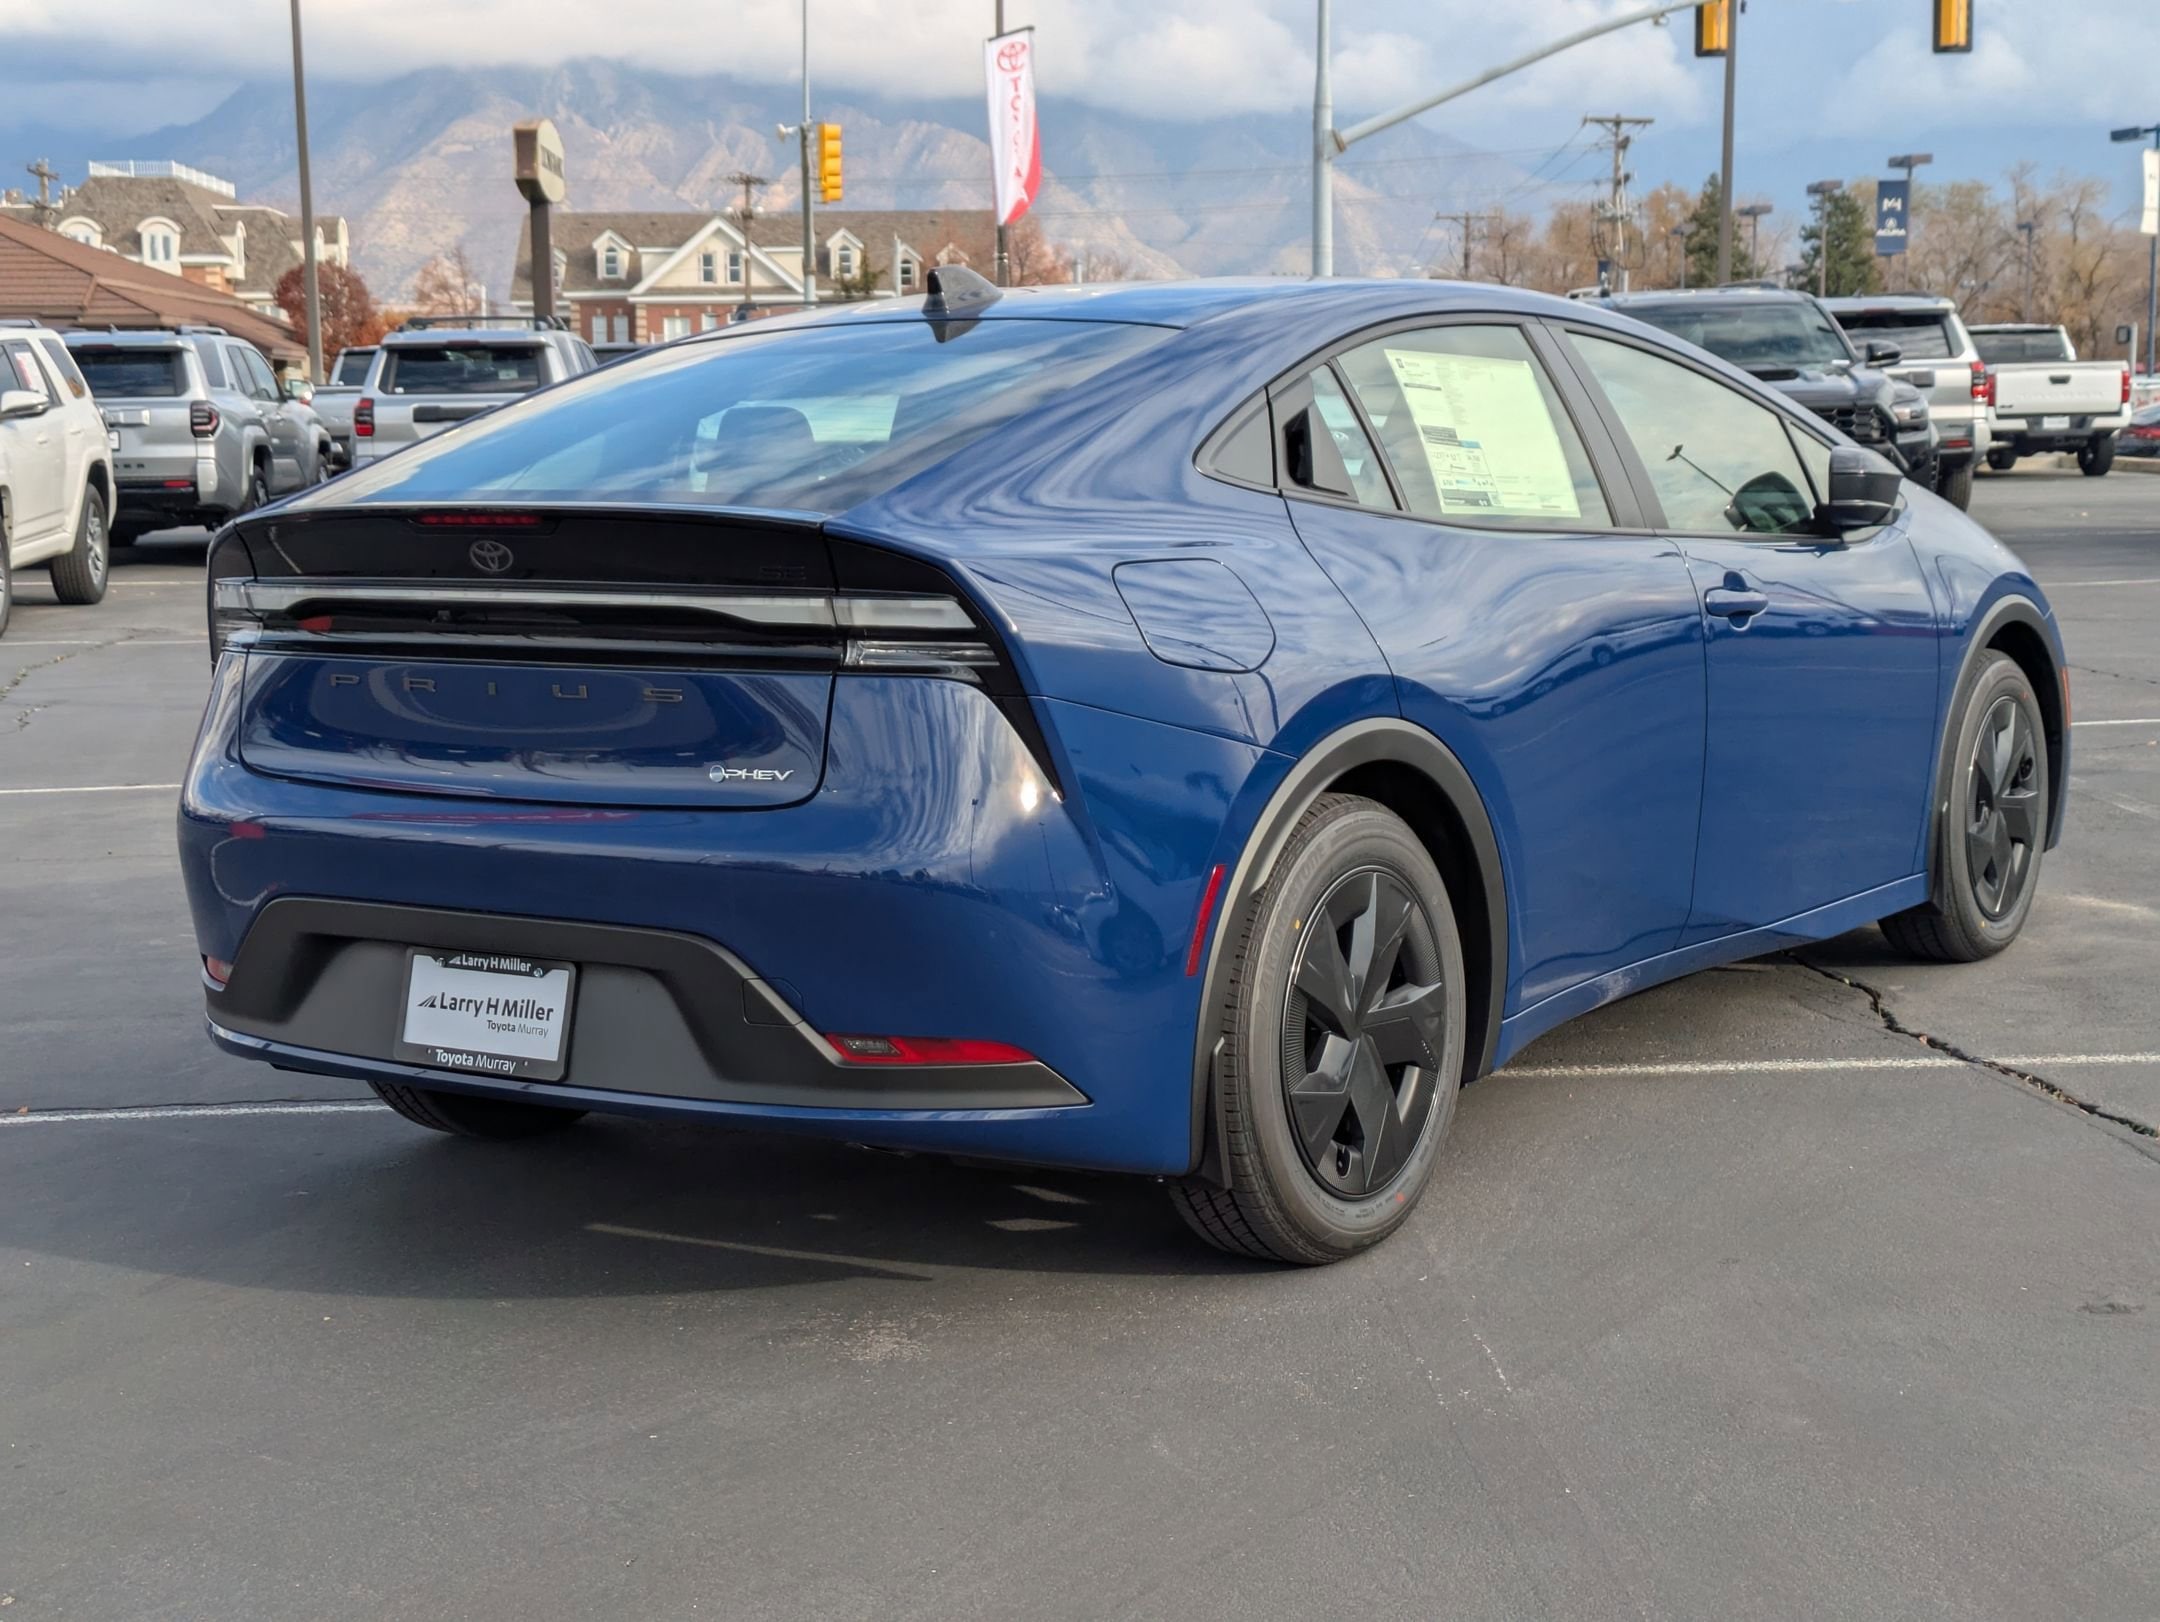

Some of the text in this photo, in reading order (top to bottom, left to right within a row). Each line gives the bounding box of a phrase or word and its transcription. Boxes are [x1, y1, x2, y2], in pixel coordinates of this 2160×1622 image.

[330, 673, 684, 703] PRIUS
[462, 954, 531, 972] Larry H Miller
[440, 992, 554, 1021] Larry H Miller
[487, 1020, 549, 1038] Toyota Murray
[436, 1049, 516, 1074] Toyota Murray
